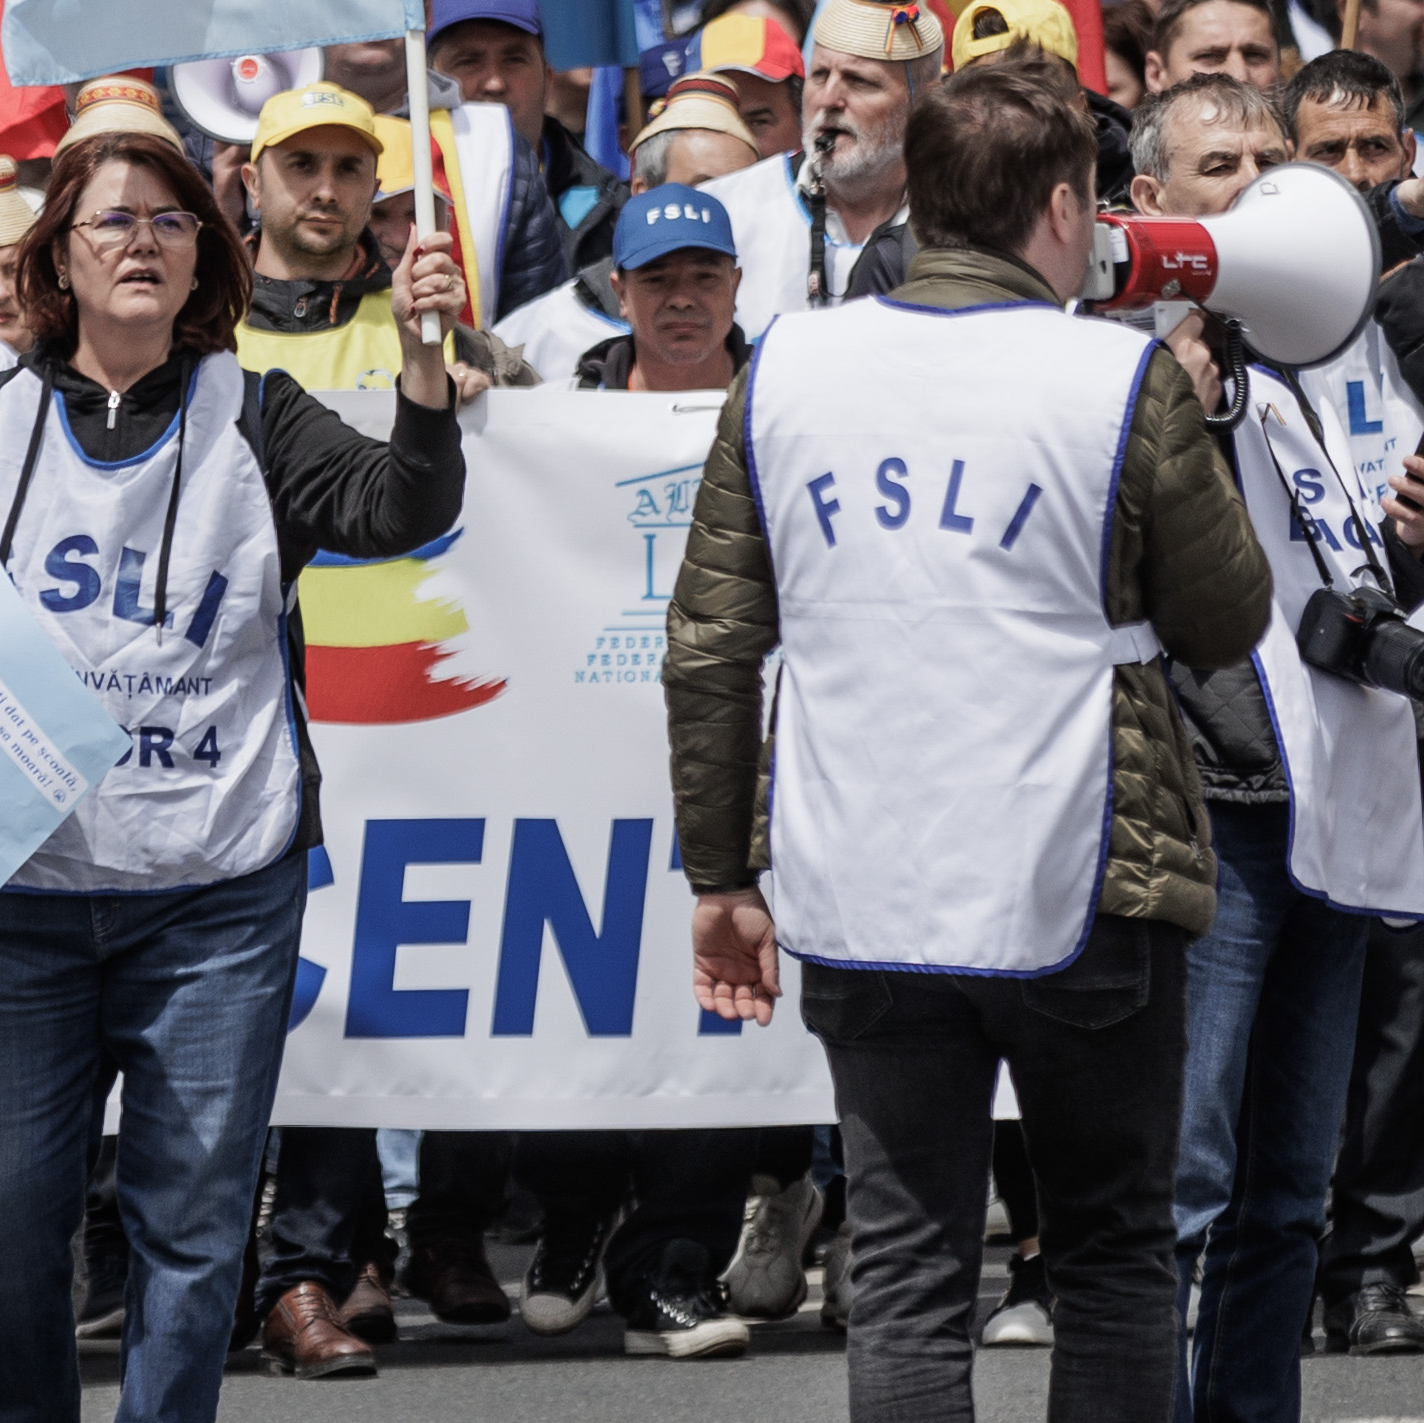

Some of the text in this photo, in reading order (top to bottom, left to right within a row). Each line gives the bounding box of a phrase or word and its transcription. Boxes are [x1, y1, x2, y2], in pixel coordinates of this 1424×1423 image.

[646, 202, 712, 226] FSLI
[804, 456, 1045, 552] FSLI
[4, 702, 26, 730] dat
[20, 726, 40, 750] pe
[192, 724, 222, 769] 4
